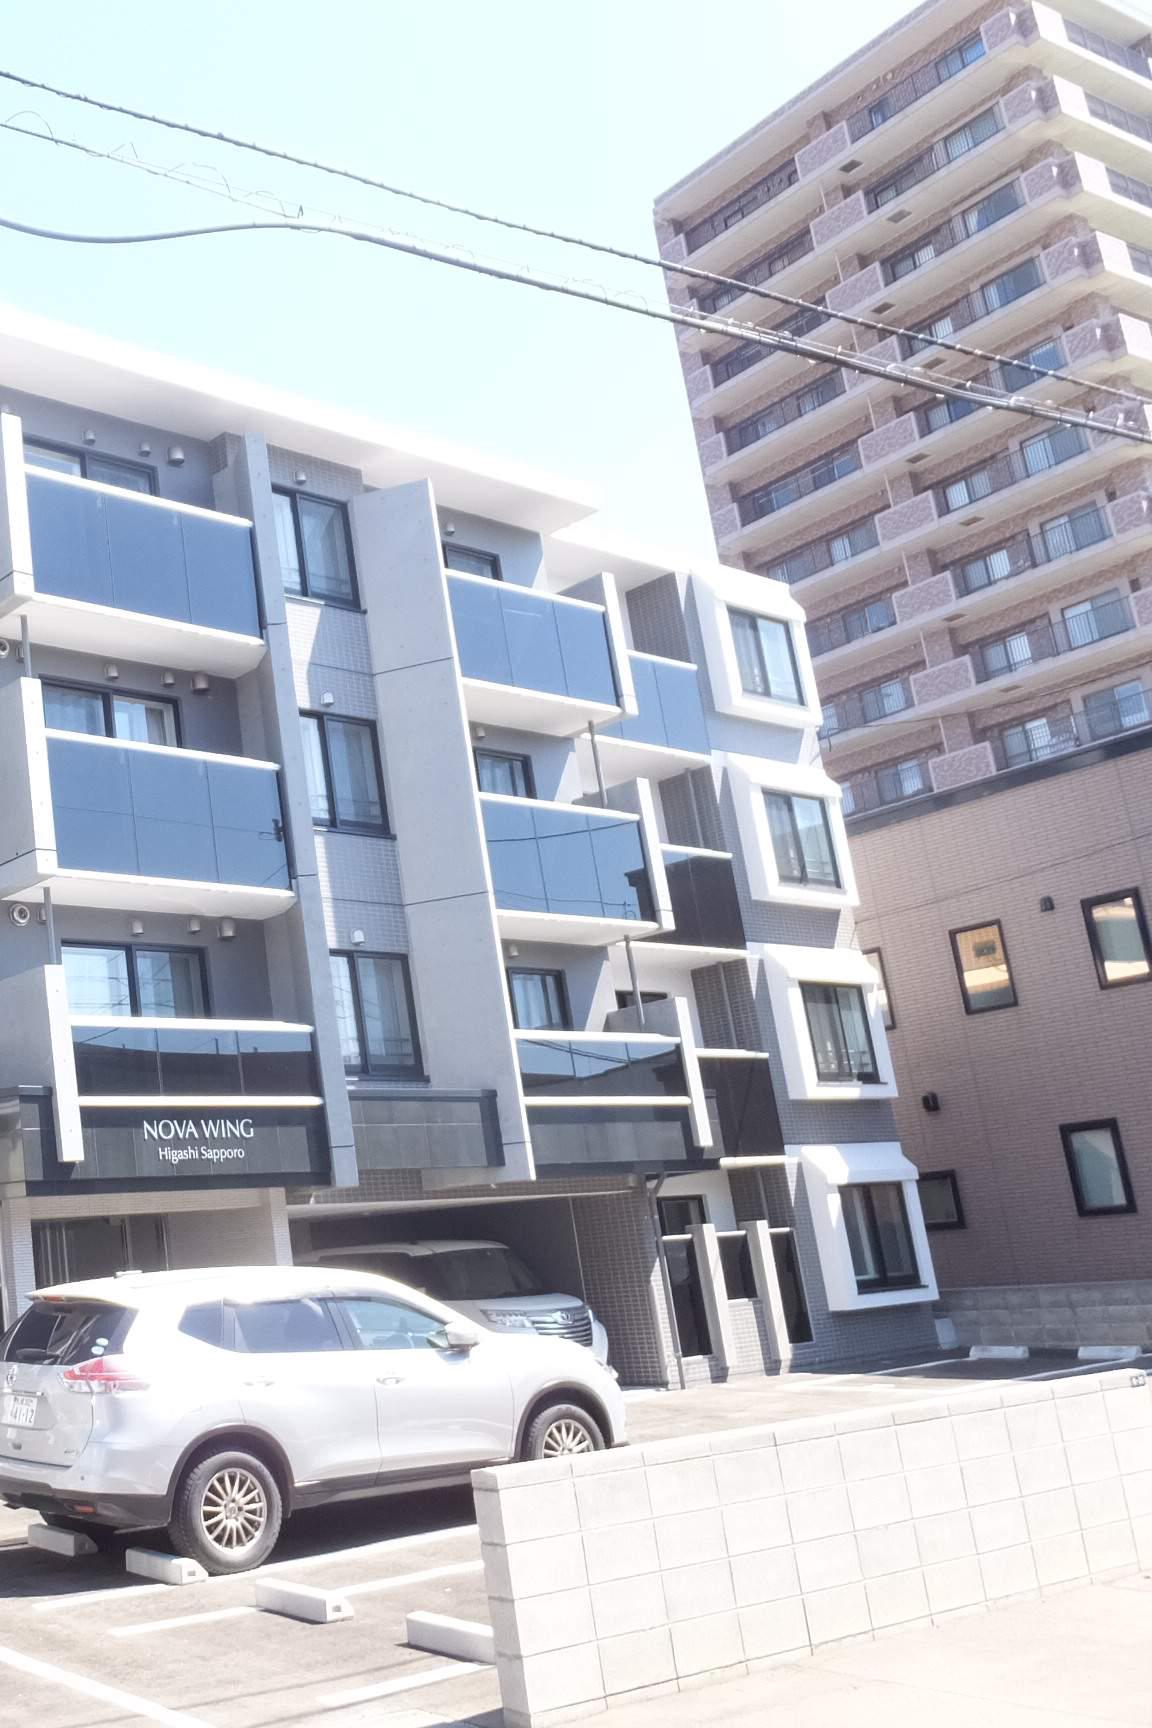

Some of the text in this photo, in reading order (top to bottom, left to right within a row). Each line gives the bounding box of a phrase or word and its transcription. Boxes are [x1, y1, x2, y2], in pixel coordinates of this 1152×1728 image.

[143, 1118, 255, 1140] NOVA WING
[158, 1146, 245, 1164] Higashi Sapporo
